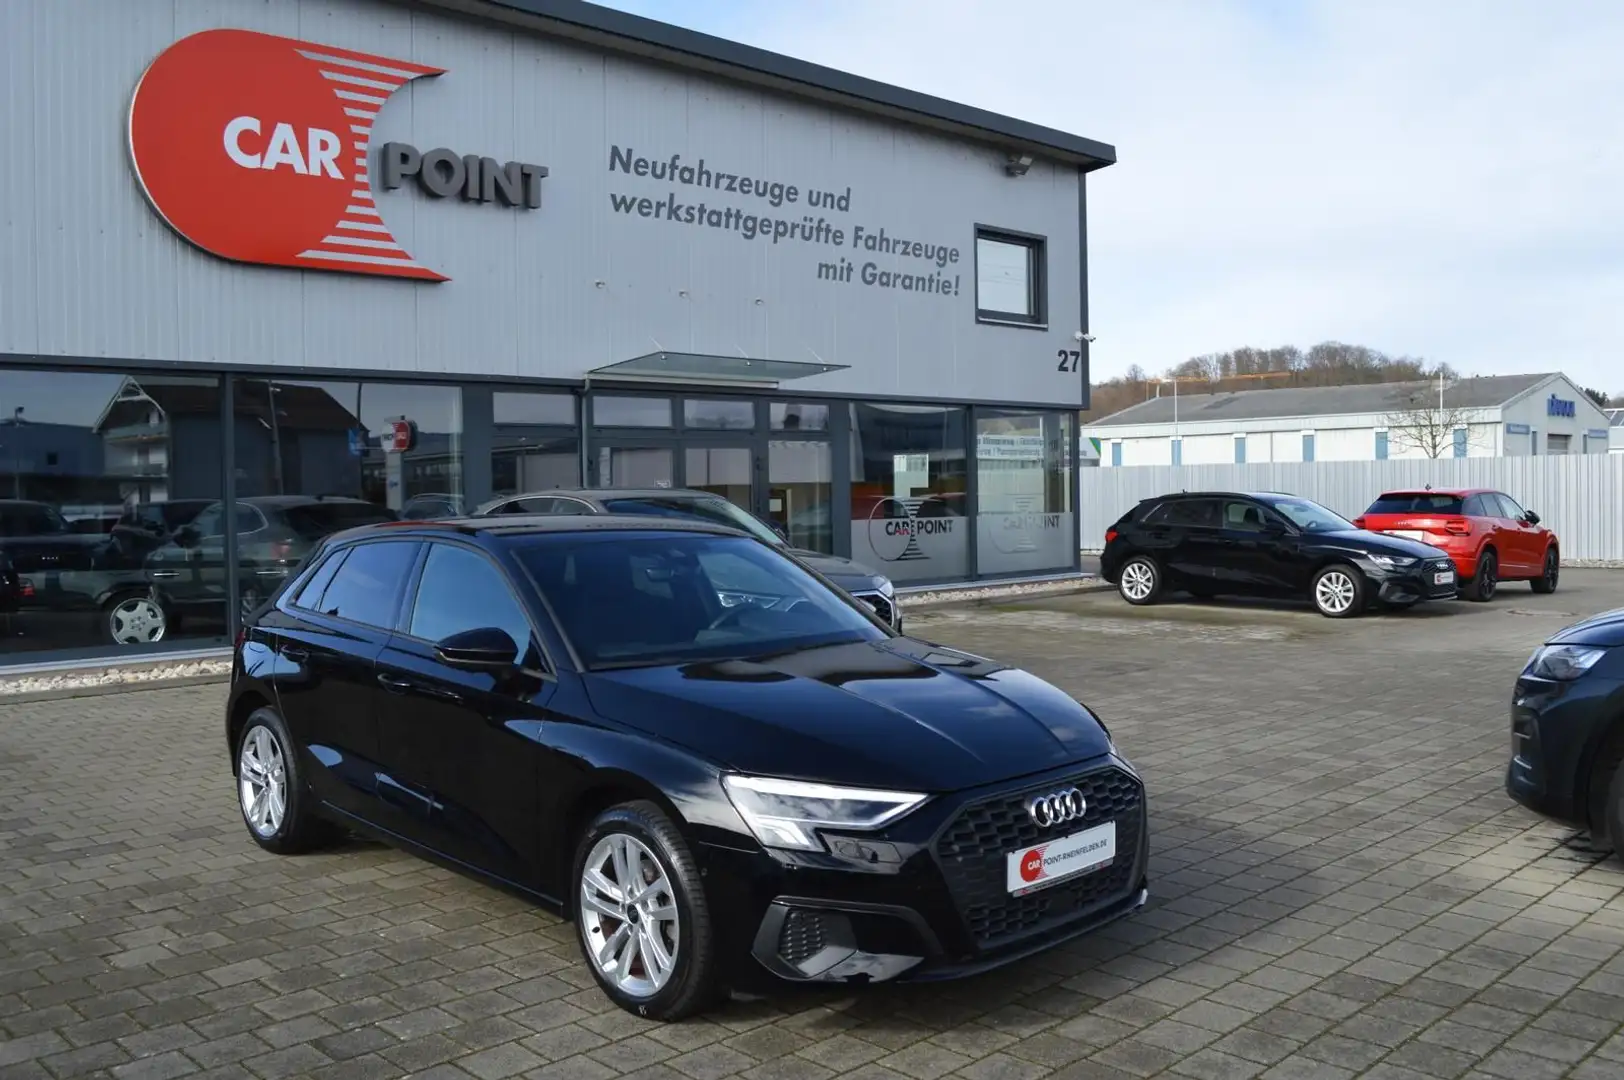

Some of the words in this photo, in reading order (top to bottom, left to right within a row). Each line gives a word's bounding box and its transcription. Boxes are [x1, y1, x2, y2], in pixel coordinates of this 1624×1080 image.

[223, 115, 345, 180] CAR
[382, 141, 549, 210] POINT
[608, 145, 799, 209] Neufahrzeuge
[808, 188, 851, 213] und
[610, 191, 845, 246] werkstattgeprüfte
[853, 226, 961, 268] Fahrzeuge
[818, 258, 854, 283] mit
[861, 267, 961, 297] Garantie!
[1057, 350, 1081, 373] 27
[885, 520, 910, 536] CAR
[916, 519, 954, 535] POINT
